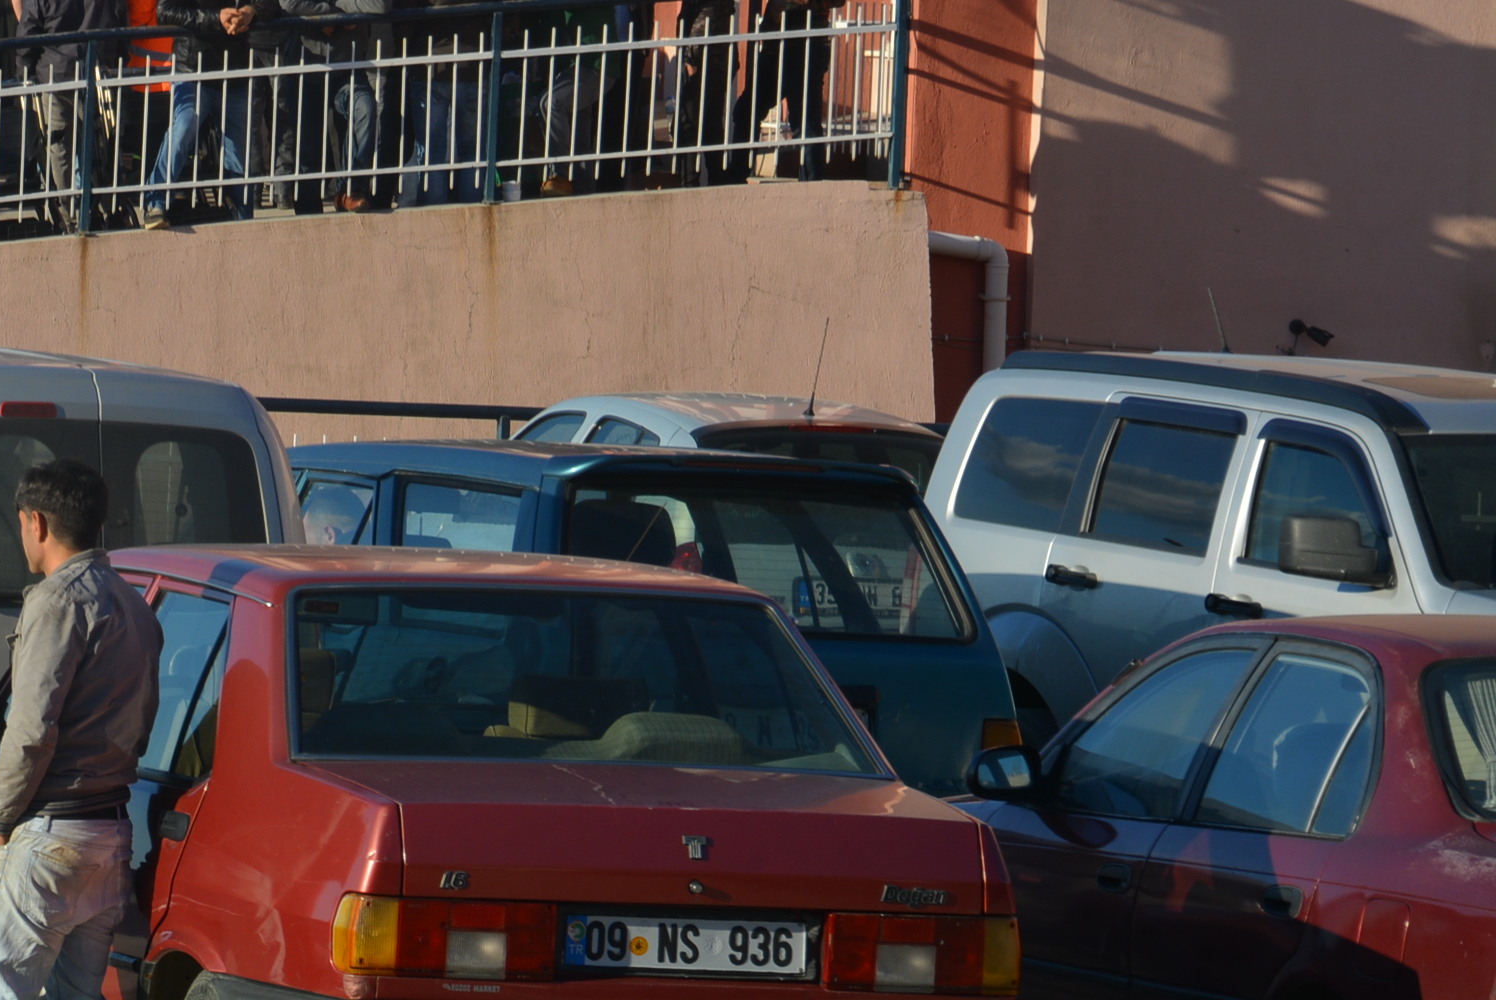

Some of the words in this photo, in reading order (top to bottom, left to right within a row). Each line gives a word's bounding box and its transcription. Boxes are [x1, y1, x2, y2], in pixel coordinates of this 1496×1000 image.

[568, 943, 584, 955] TR
[585, 920, 629, 962] 09
[656, 922, 701, 964] NS
[728, 925, 794, 968] 936
[473, 985, 500, 993] MARKET
